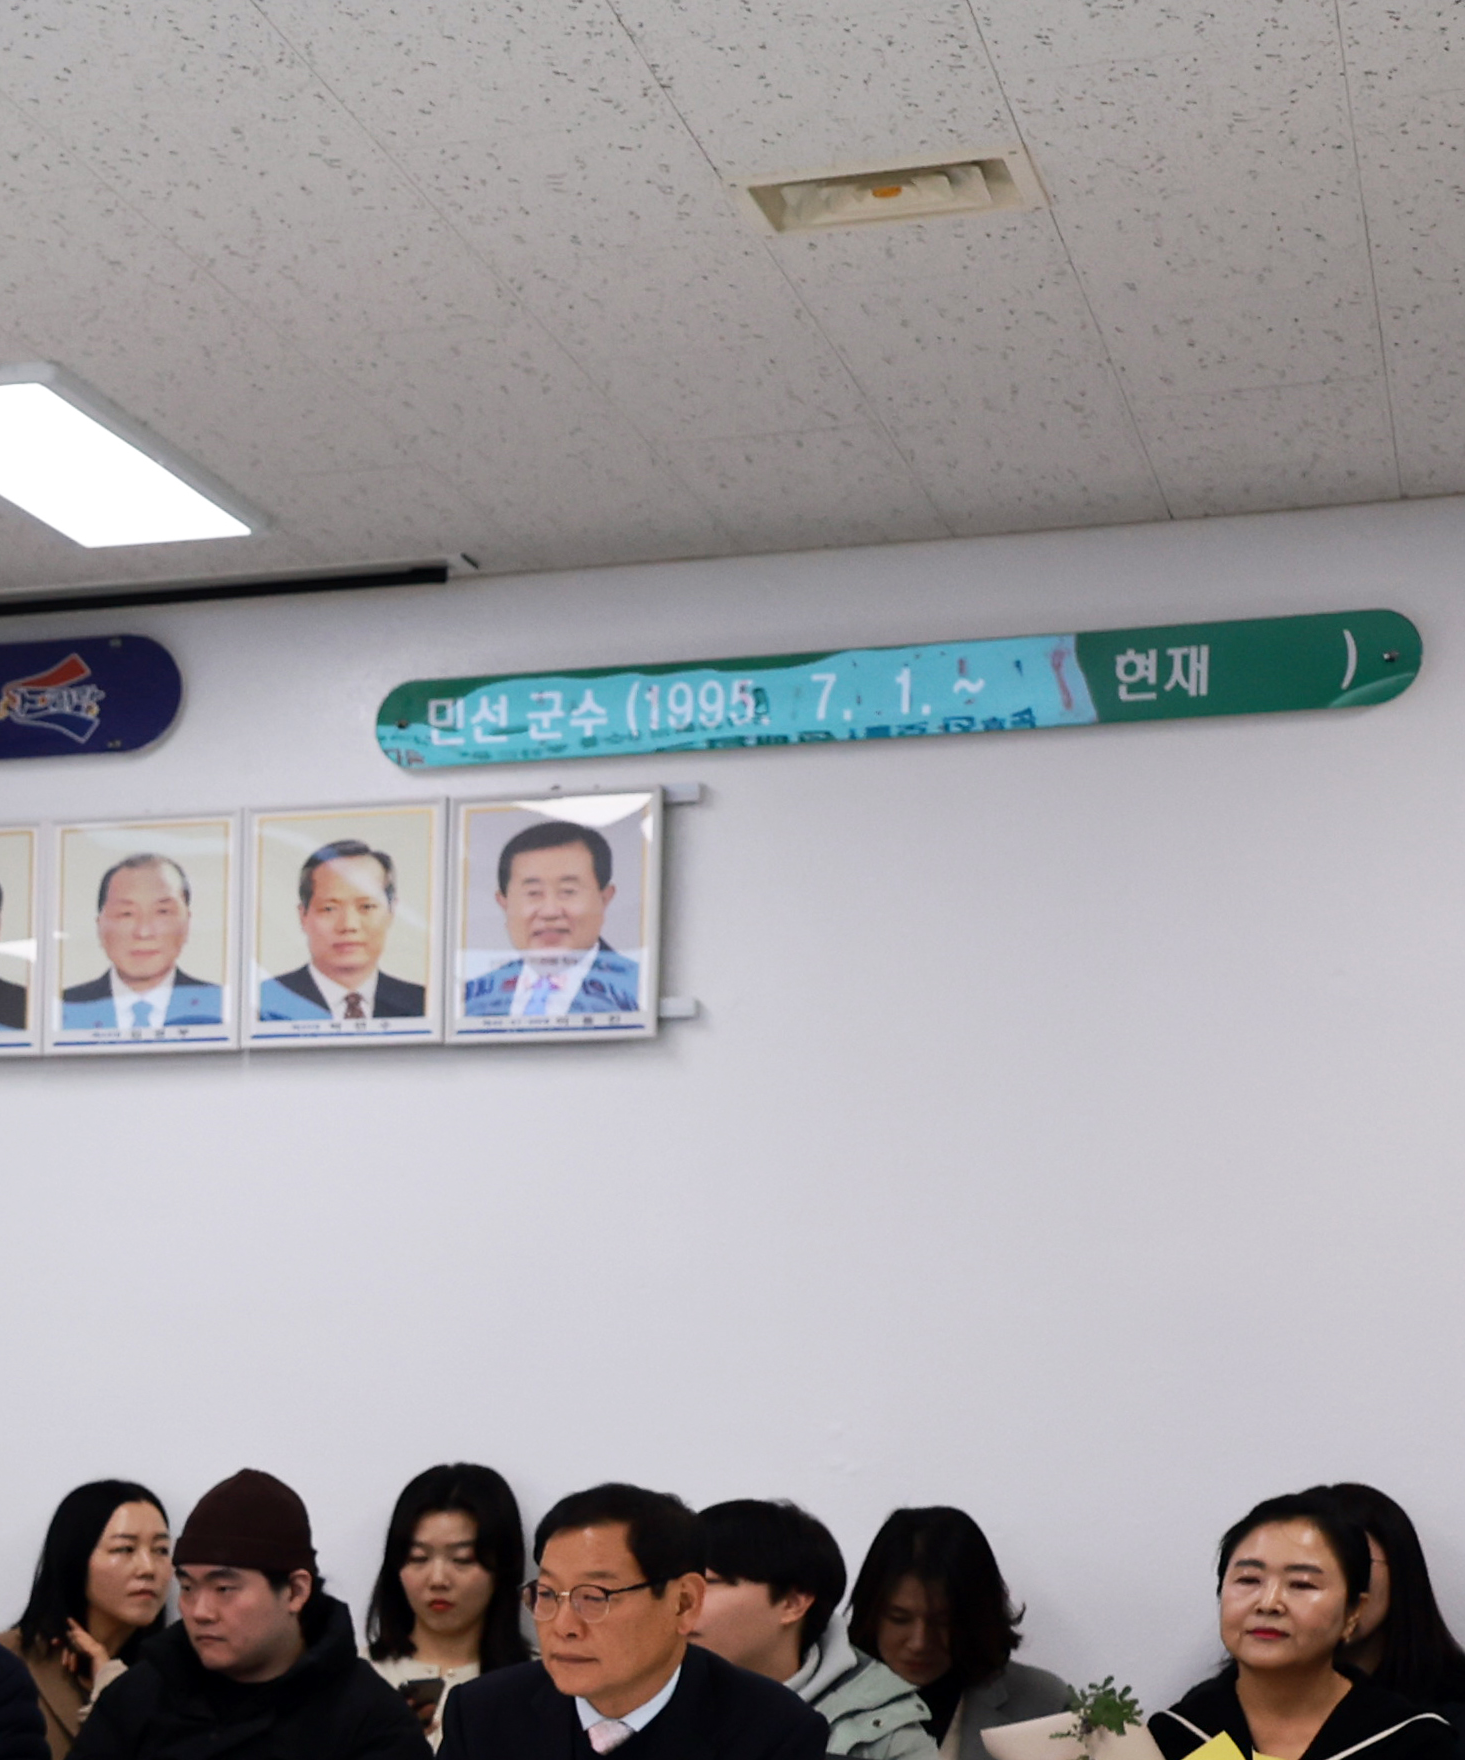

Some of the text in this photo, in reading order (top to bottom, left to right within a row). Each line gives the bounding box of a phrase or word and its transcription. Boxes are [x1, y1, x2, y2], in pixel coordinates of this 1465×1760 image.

[428, 695, 508, 746] 민선
[527, 688, 608, 740] 군수
[626, 679, 771, 738] (1995.
[810, 673, 853, 721] 7.
[896, 667, 932, 716] 1.
[1115, 644, 1210, 702] 현재
